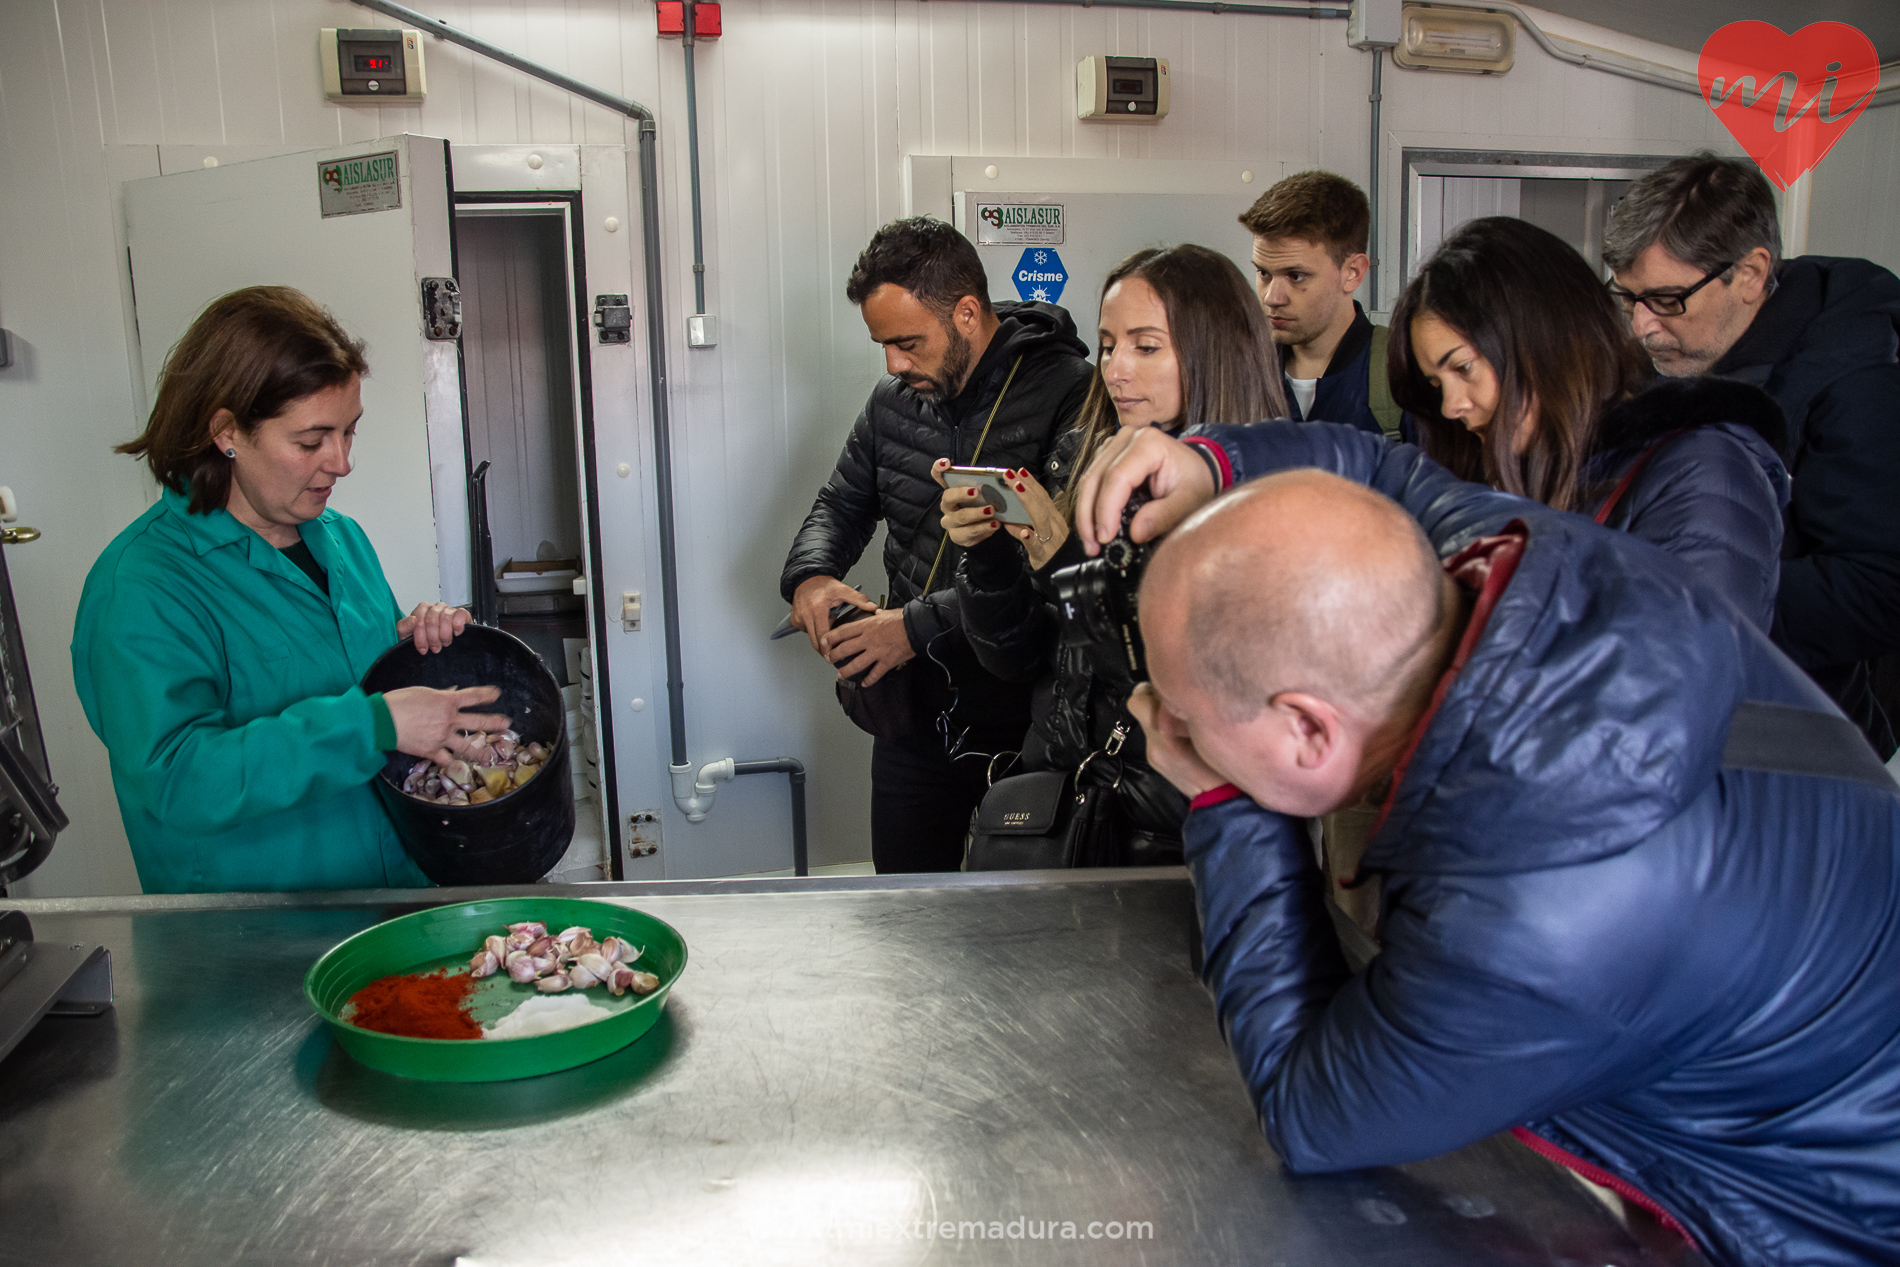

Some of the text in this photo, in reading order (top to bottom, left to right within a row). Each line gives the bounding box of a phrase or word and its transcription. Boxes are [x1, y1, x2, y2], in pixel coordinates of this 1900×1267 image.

[343, 157, 395, 186] AISLASUR
[1004, 207, 1061, 225] AISLASUR
[1018, 269, 1064, 282] Crisme
[1003, 812, 1030, 821] GUESS
